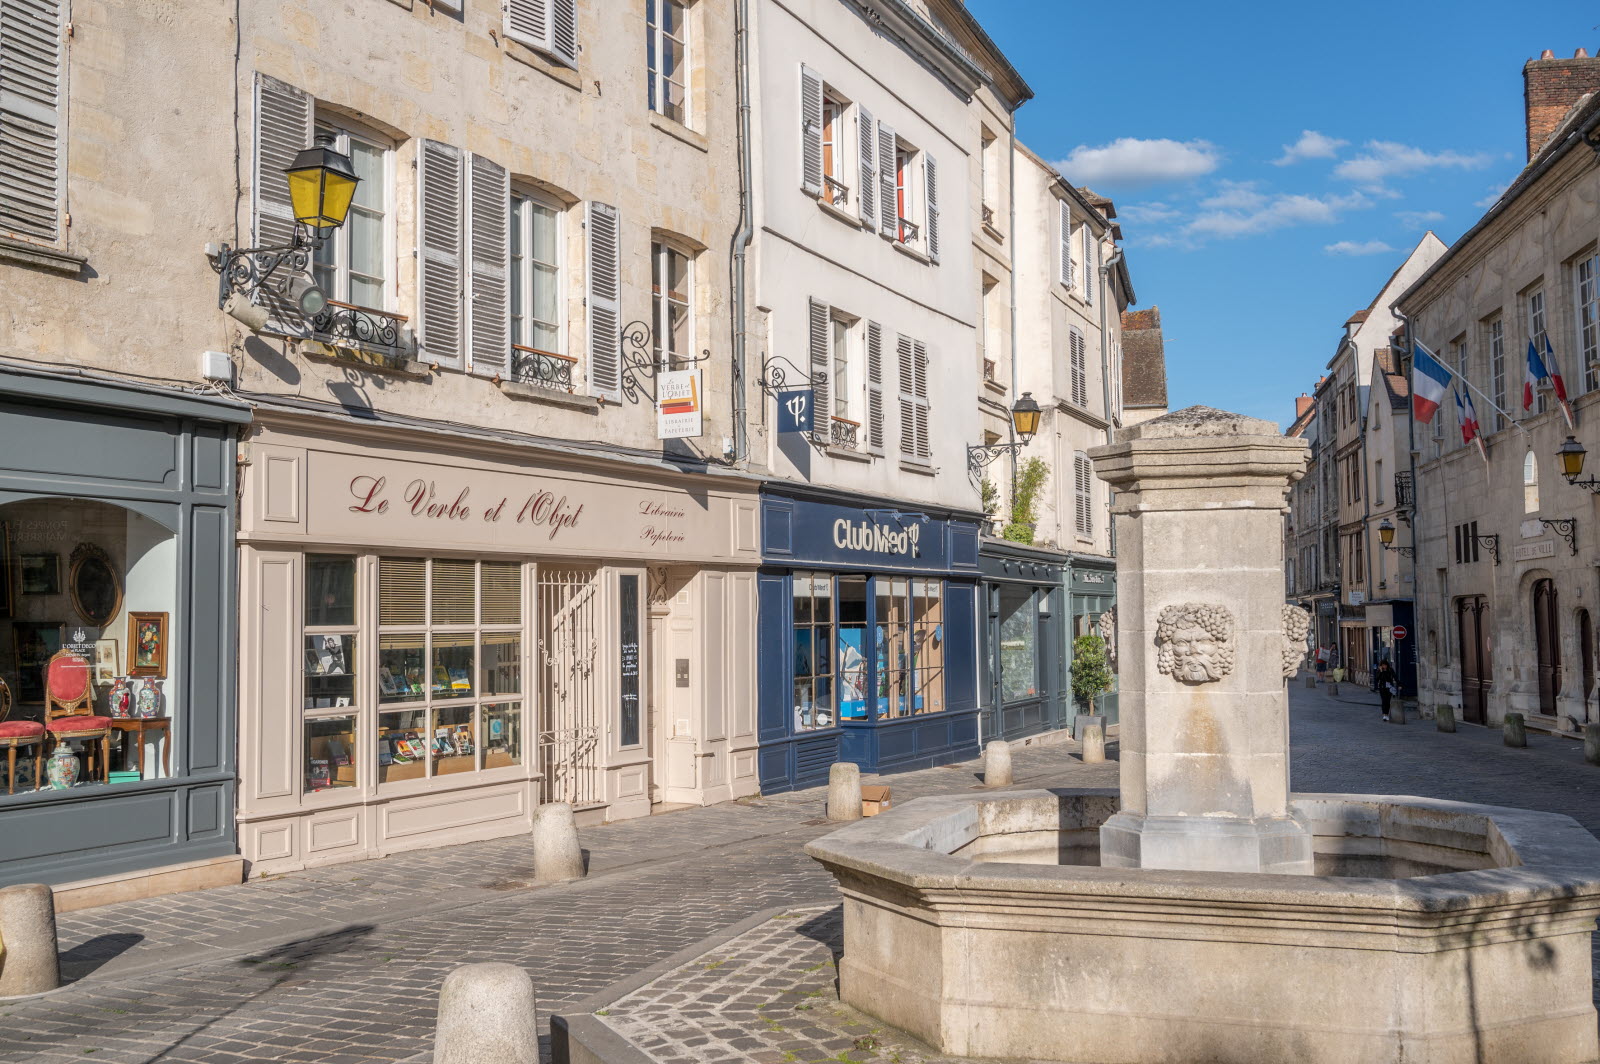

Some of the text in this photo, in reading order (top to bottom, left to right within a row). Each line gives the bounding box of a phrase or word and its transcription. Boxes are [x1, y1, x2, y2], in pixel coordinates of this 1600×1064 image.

[348, 475, 584, 540] Le Verbe et l'Objet
[639, 500, 686, 518] Librairie
[640, 524, 686, 547] Papeterie
[1538, 543, 1553, 554] VILLE
